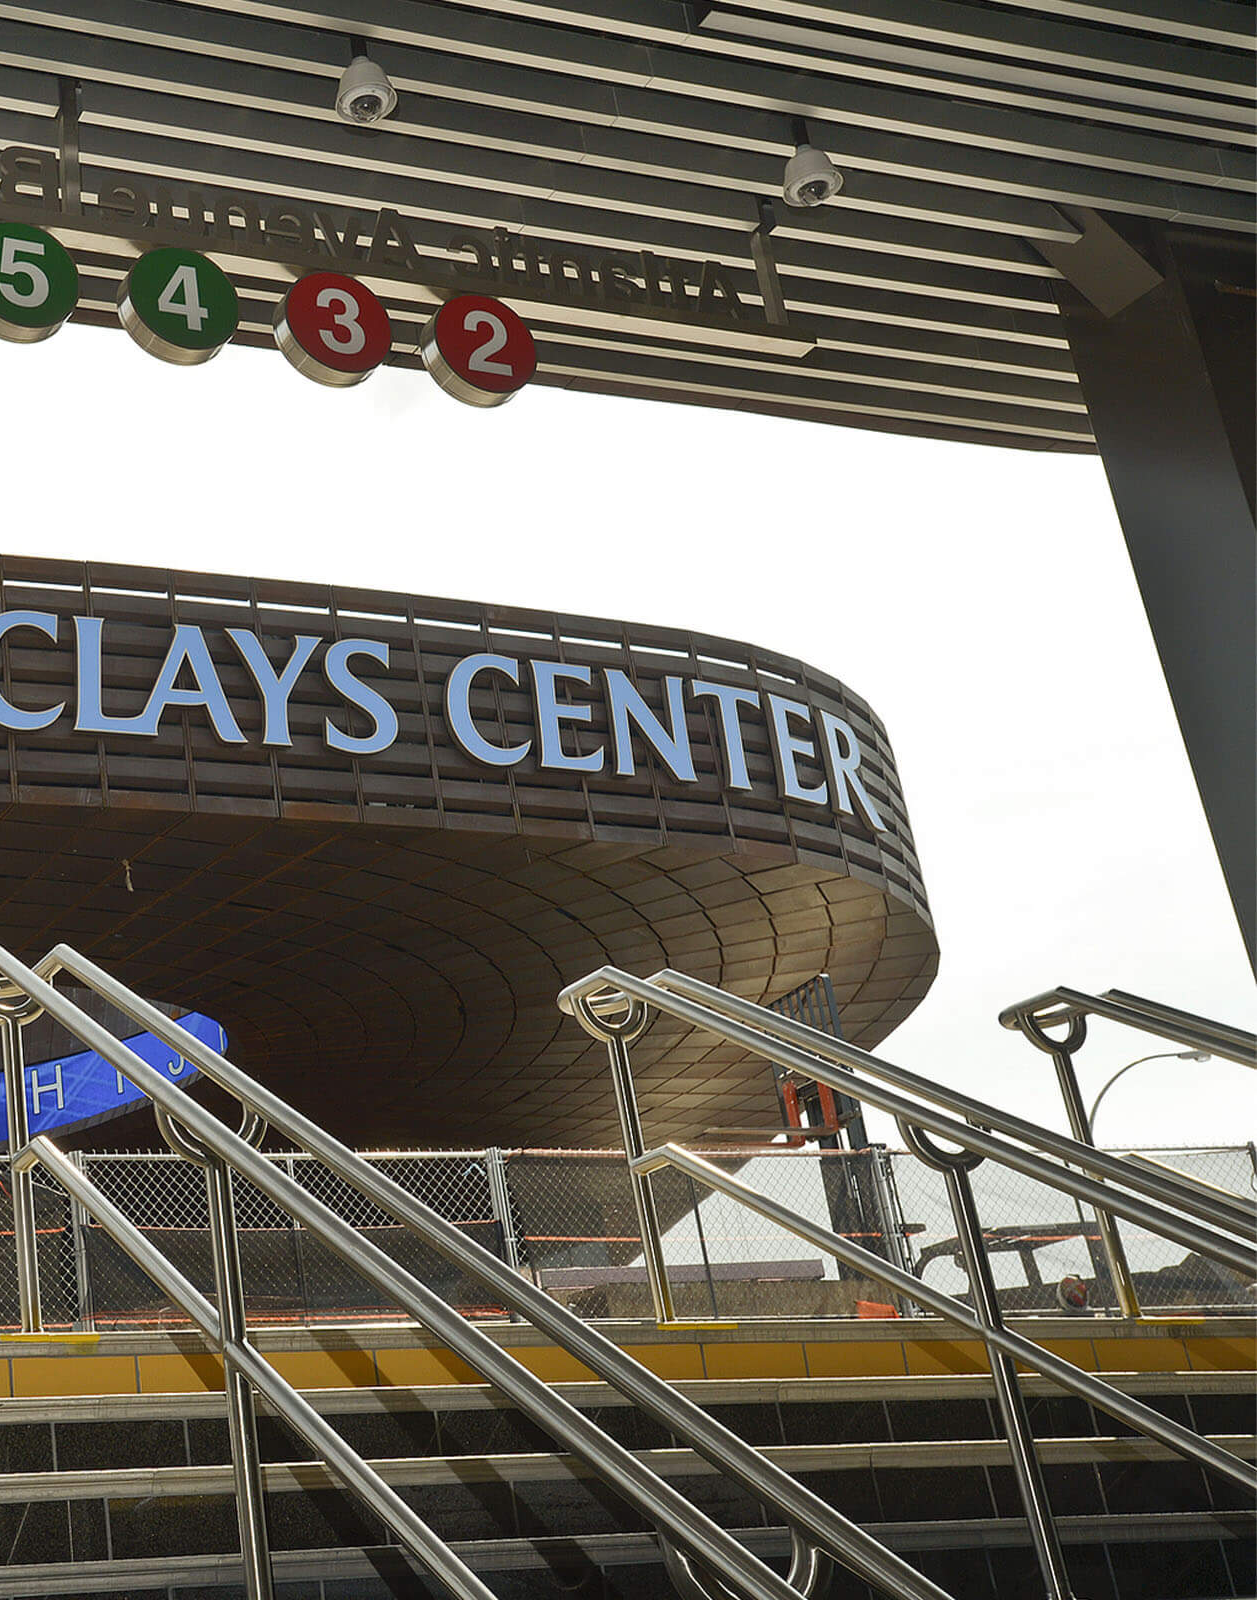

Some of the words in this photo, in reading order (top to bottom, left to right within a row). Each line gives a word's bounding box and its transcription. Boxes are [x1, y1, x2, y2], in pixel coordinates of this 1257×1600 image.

[157, 265, 209, 331] 4
[316, 287, 366, 354] 3
[463, 310, 513, 377] 2
[446, 653, 889, 833] CENTER
[31, 1064, 64, 1114] H
